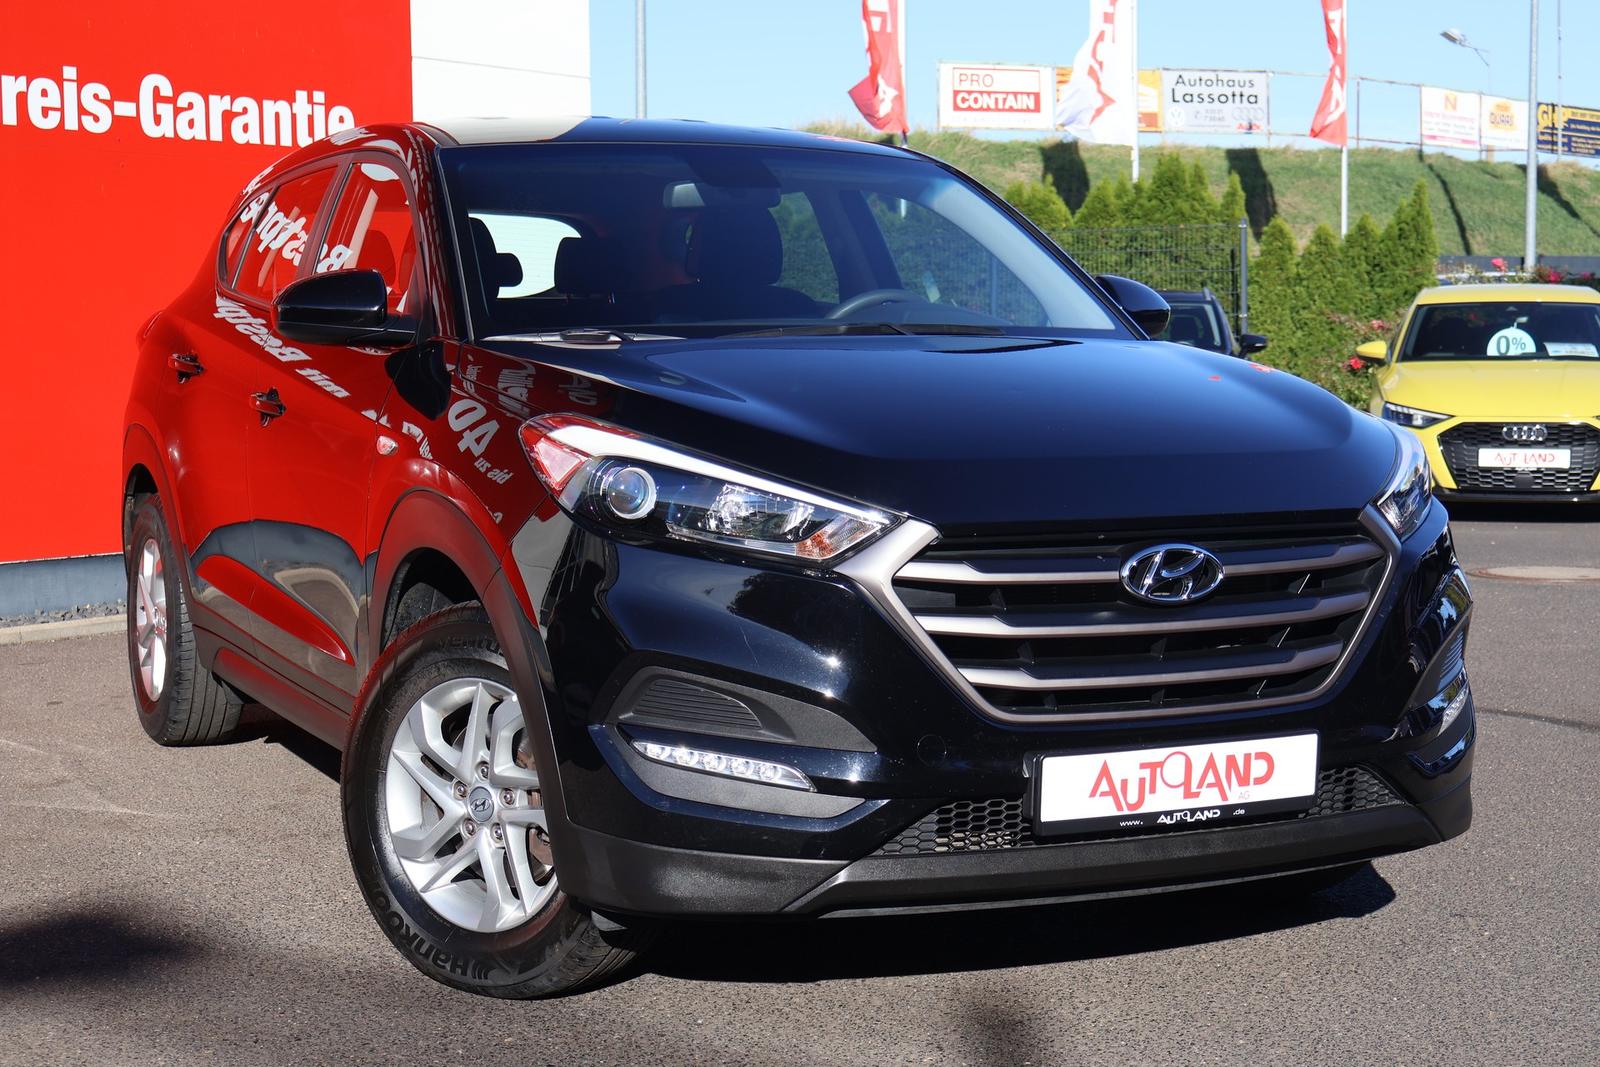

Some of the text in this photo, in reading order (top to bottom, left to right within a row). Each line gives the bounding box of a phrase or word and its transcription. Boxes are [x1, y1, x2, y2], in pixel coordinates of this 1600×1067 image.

[958, 72, 994, 88] PRO
[1174, 73, 1256, 88] Autohaus
[956, 92, 1035, 110] CONTAIN
[1170, 87, 1259, 105] Lassotta
[1089, 750, 1275, 812] AUTOLAND
[1119, 819, 1144, 828] www.
[1156, 809, 1221, 825] AUTOLAND
